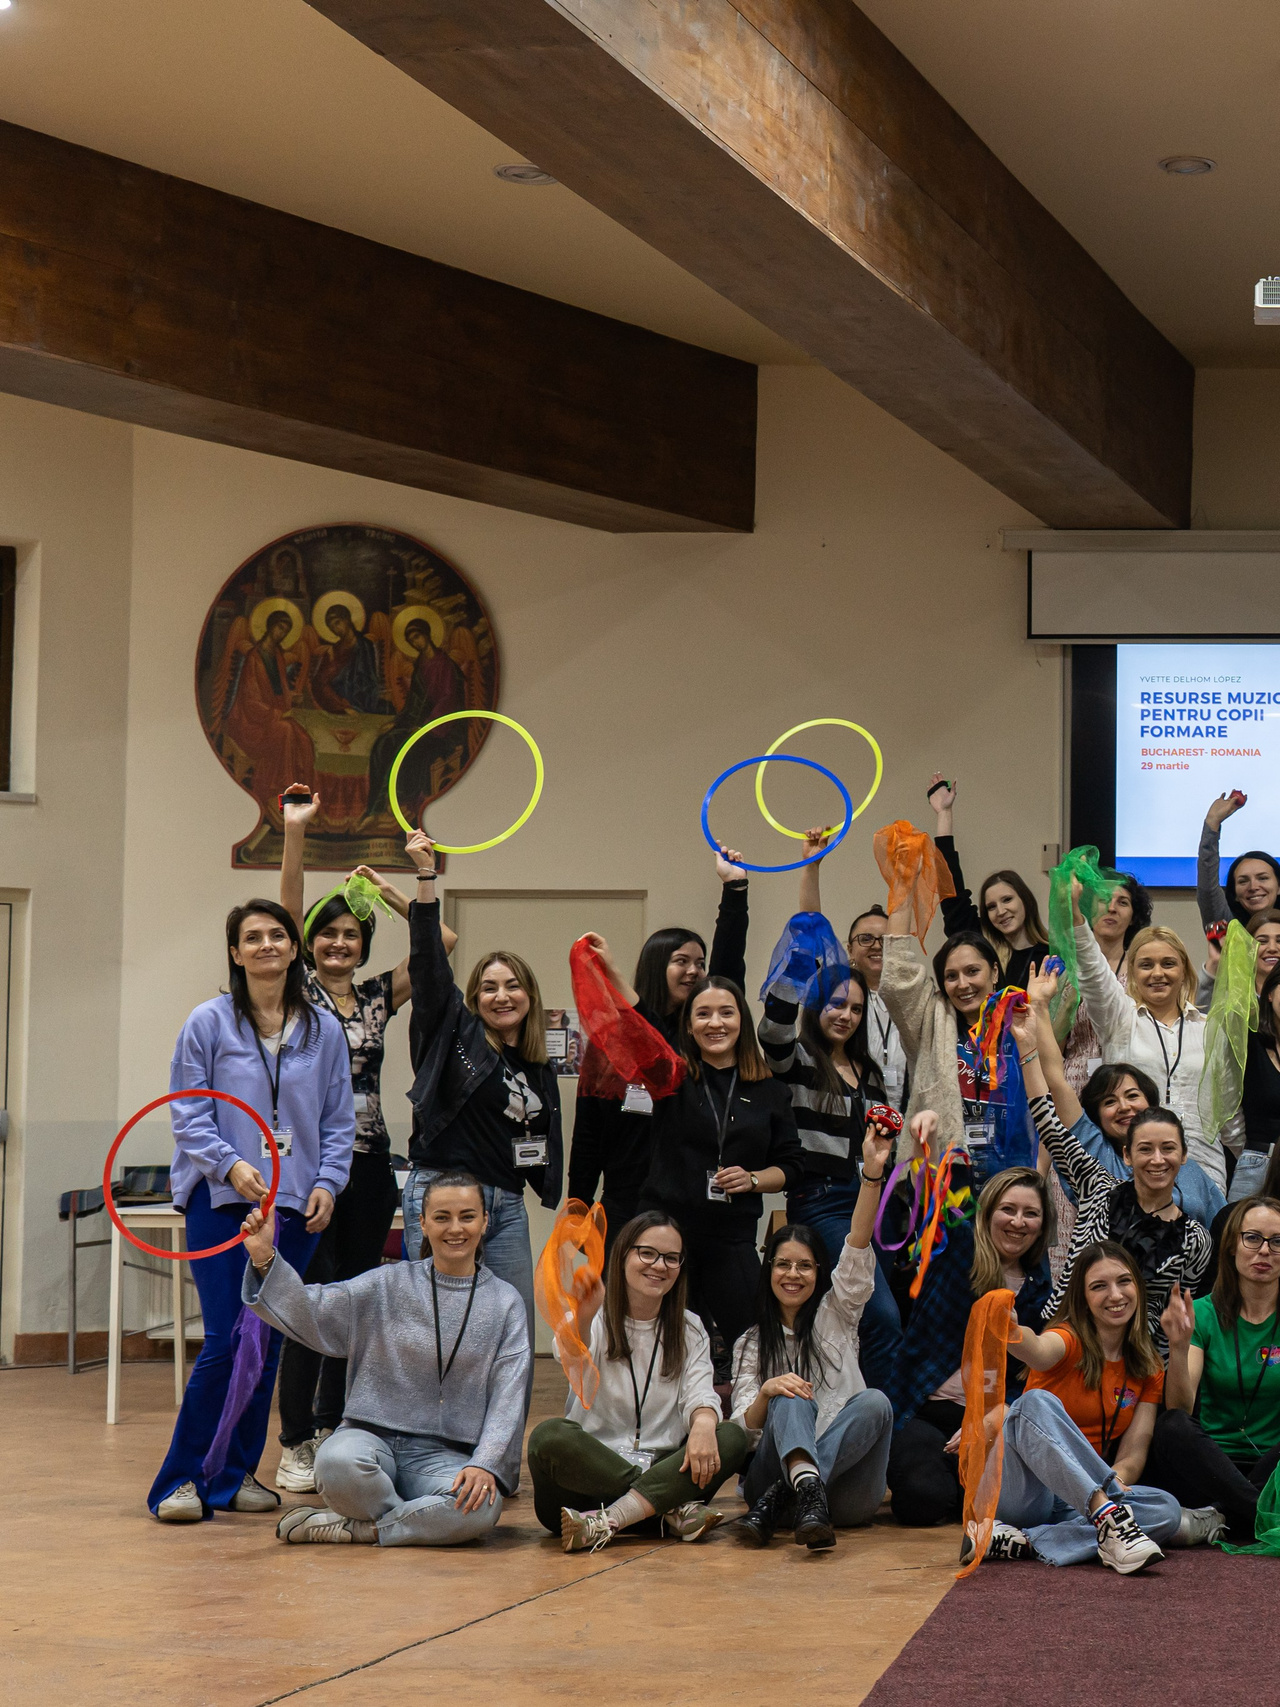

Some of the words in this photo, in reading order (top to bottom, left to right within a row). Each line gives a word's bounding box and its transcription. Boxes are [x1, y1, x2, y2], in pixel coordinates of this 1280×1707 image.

[1140, 692, 1222, 705] RESURSE
[1140, 709, 1212, 721] PENTRU
[1216, 709, 1264, 721] COPII
[1140, 725, 1228, 738] FORMARE
[1141, 748, 1208, 757] BUCHAREST-
[1210, 748, 1261, 757] ROMANIA
[1141, 762, 1153, 770] 29
[1155, 762, 1190, 770] martie
